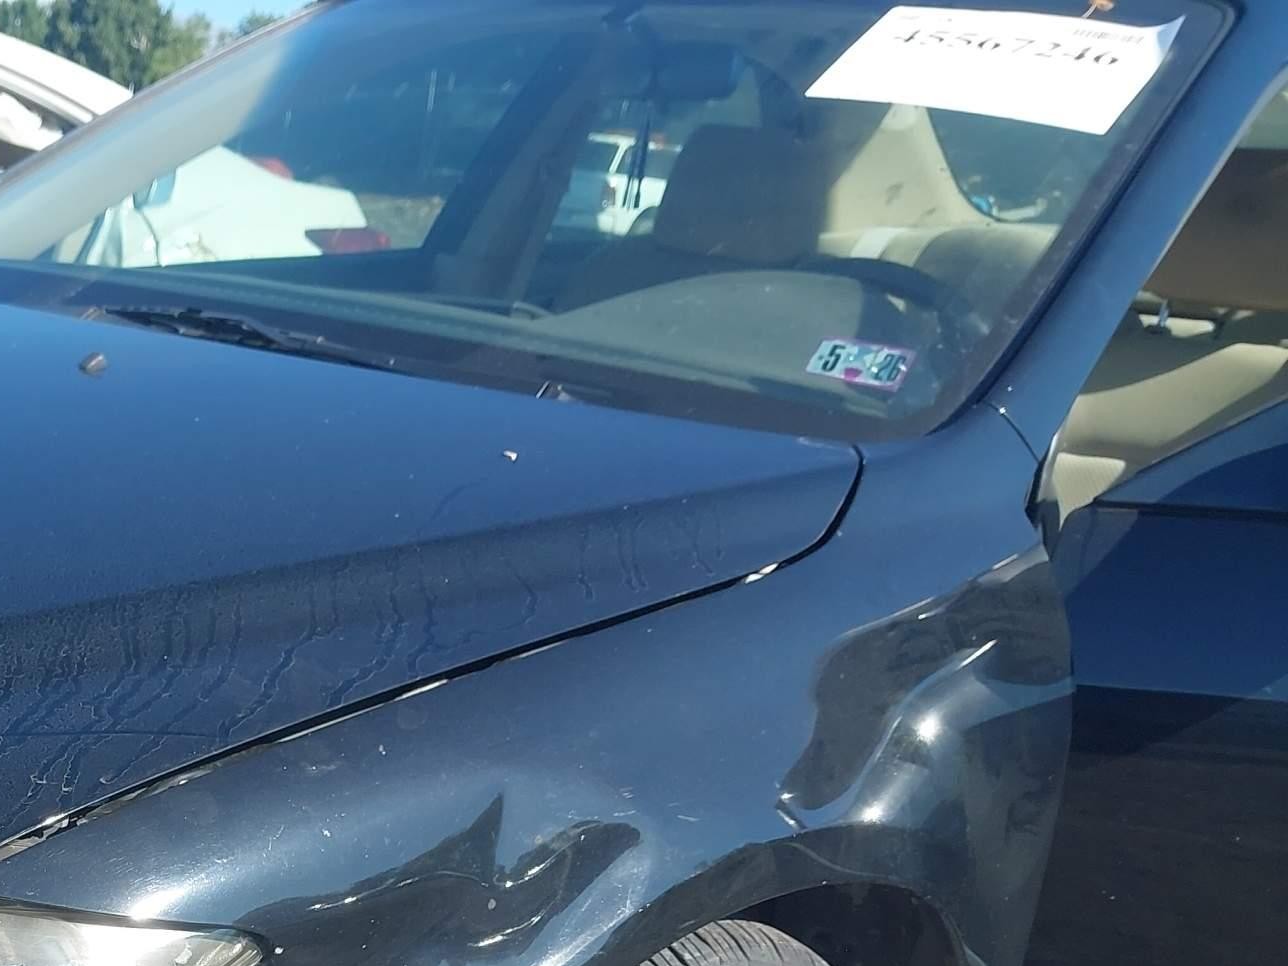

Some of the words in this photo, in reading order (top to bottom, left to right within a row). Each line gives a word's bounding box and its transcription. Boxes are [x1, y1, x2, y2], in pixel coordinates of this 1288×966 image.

[894, 27, 1120, 66] 45567246
[821, 343, 847, 372] 5
[871, 353, 907, 382] 26
